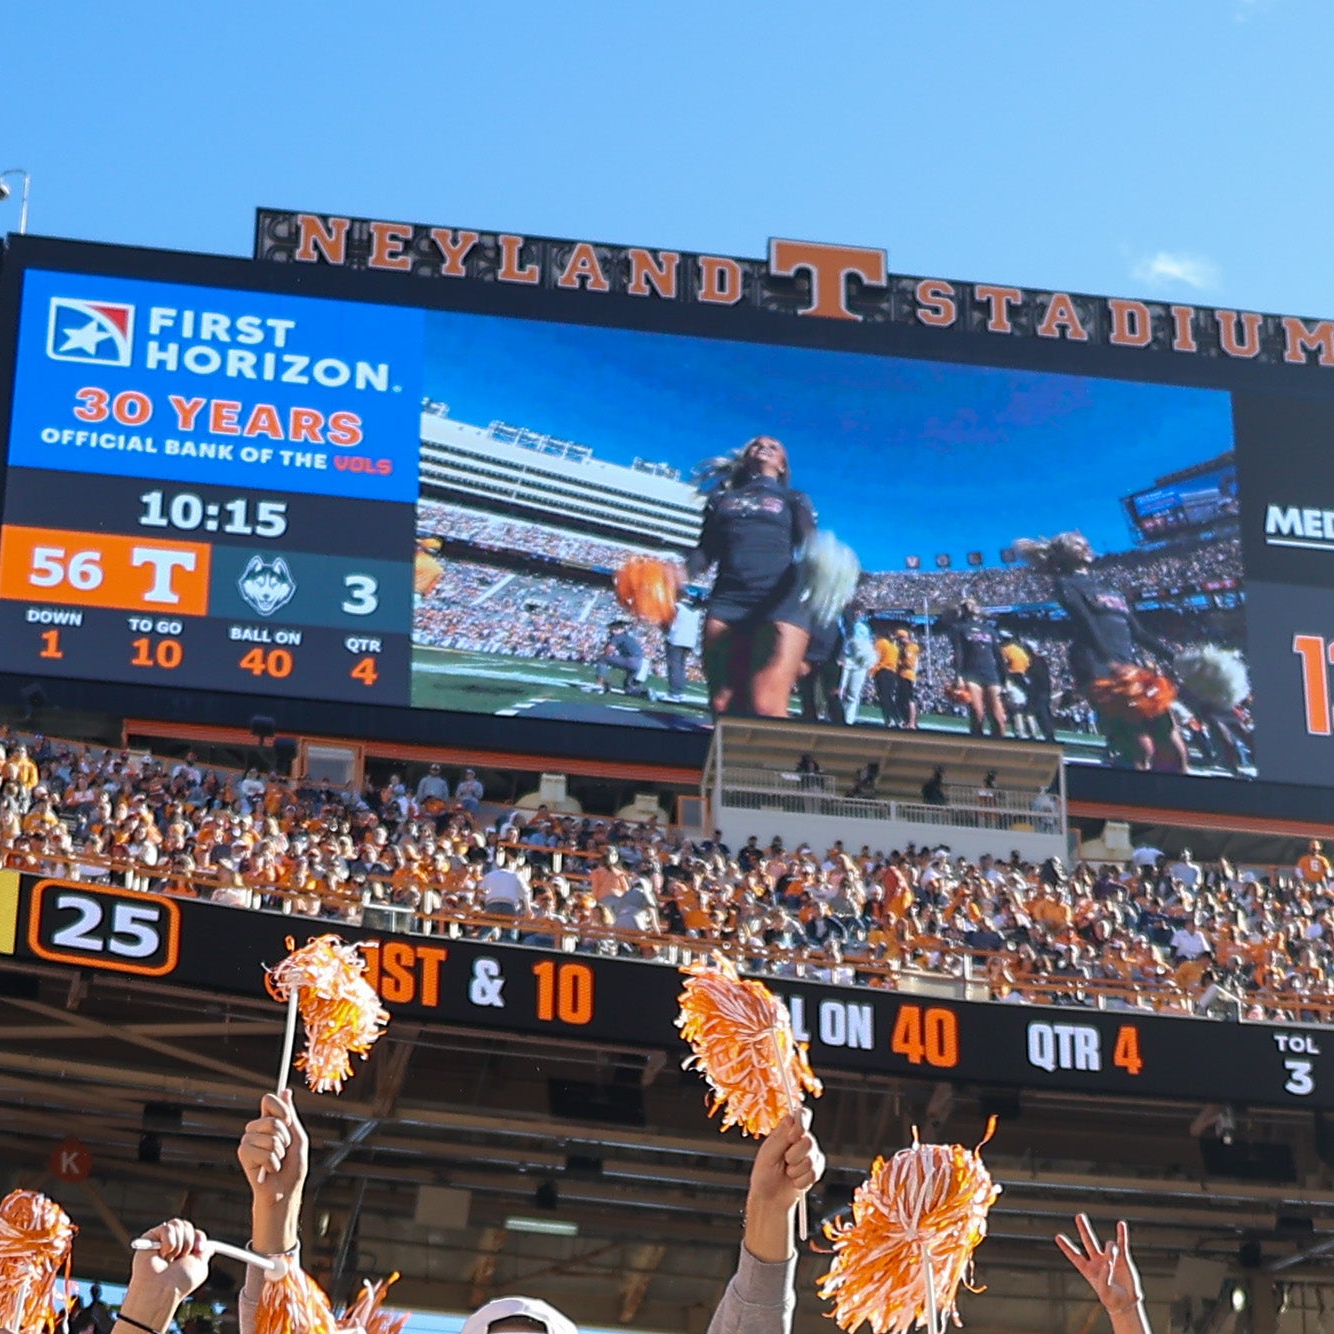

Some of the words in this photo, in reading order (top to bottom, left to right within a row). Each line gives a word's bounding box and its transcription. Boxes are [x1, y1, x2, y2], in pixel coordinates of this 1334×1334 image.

[295, 214, 743, 305] NEYLAND
[769, 237, 887, 322] T
[148, 307, 296, 347] FIRST
[73, 387, 153, 426] 30
[169, 394, 364, 447] YEARS
[41, 427, 157, 454] OFFICIAL
[164, 439, 234, 460] BANK
[240, 447, 274, 464] OF
[280, 451, 328, 469] THE
[333, 456, 394, 475] VOLS
[138, 490, 288, 537] 10:15
[28, 546, 104, 590] 56
[131, 546, 197, 604] T
[341, 574, 379, 615] 3
[25, 609, 83, 627] DOWN
[128, 617, 153, 633] TO
[156, 620, 183, 635] GO
[228, 627, 272, 643] BALL
[276, 630, 302, 646] ON
[39, 629, 64, 660] 1
[130, 637, 184, 669] 10
[238, 648, 294, 678] 40
[344, 637, 382, 654] QTR
[351, 657, 379, 686] 4
[50, 896, 161, 959] 25
[468, 958, 506, 1007] &
[533, 961, 595, 1025] 10
[820, 1001, 875, 1050] ON
[891, 1006, 960, 1068] 40
[1026, 1021, 1101, 1073] QTR
[1112, 1025, 1143, 1075] 4
[1273, 1034, 1320, 1056] TOL
[1284, 1058, 1315, 1096] 3
[59, 1150, 81, 1174] K
